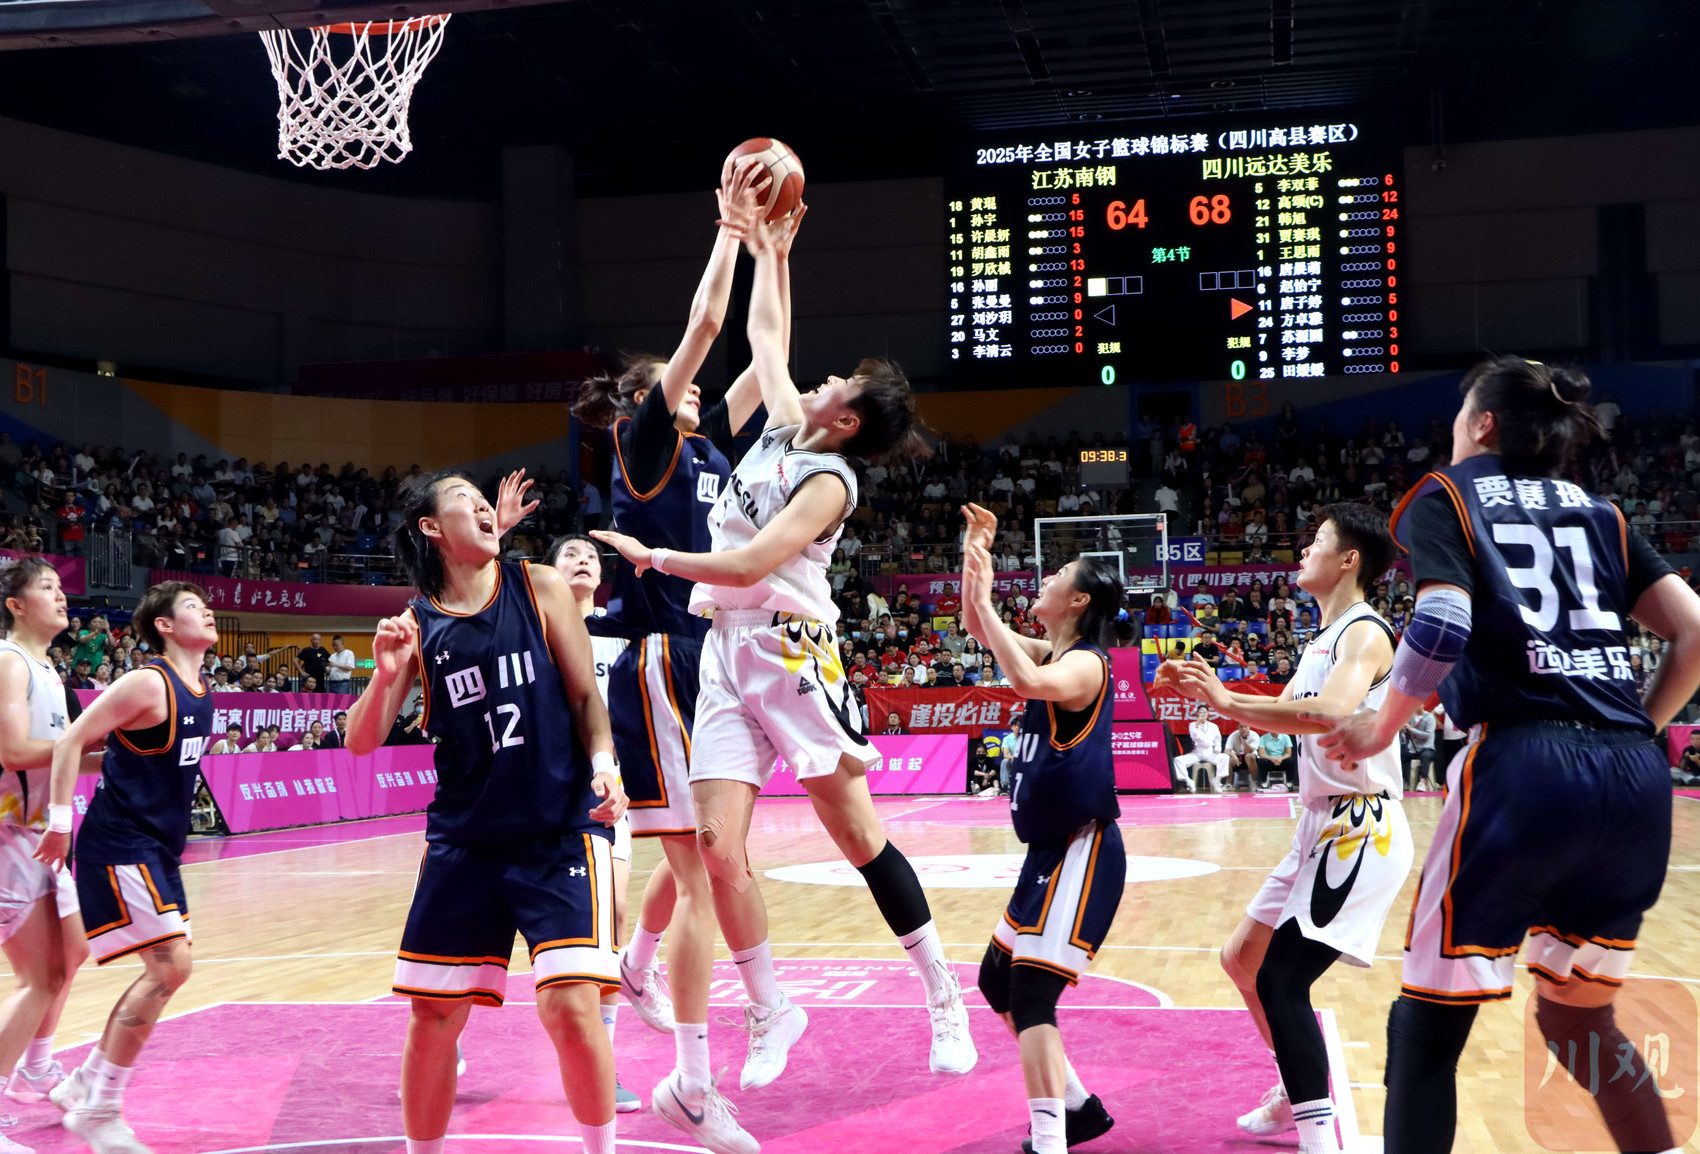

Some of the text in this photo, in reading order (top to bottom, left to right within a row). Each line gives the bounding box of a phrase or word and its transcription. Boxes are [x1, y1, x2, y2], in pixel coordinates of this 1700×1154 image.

[1202, 151, 1332, 180] 四川远达美乐
[1031, 165, 1117, 189] 江苏南钢
[1255, 183, 1263, 193] 5
[1385, 174, 1393, 185] 6
[949, 202, 962, 211] 18
[1072, 194, 1080, 204] 5
[1256, 200, 1270, 210] 12
[1382, 191, 1398, 202] 12
[949, 218, 955, 228] 1
[1069, 210, 1084, 221] 15
[1106, 198, 1148, 231] 64
[1189, 194, 1232, 226] 68
[1256, 209, 1398, 227] 21 韩旭 24
[950, 234, 963, 244] 15
[1070, 227, 1084, 237] 15
[1256, 226, 1394, 243] 31 贾赛琪 9
[950, 251, 962, 260] 11
[1073, 243, 1080, 253] 3
[1151, 246, 1191, 264] 第4节
[1257, 242, 1395, 260] 1 王思雨 9
[951, 267, 964, 276] 19
[1070, 260, 1085, 270] 13
[1257, 266, 1272, 277] 16
[1387, 259, 1395, 270] 0
[951, 283, 964, 292] 16
[1074, 276, 1082, 287] 2
[1257, 284, 1265, 294] 6
[1388, 276, 1396, 287] 0
[951, 299, 958, 309] 5
[1074, 293, 1082, 303] 9
[1258, 300, 1272, 310] 11
[1388, 293, 1397, 304] 5
[951, 315, 965, 325] 27
[1074, 309, 1082, 320] 0
[1258, 317, 1273, 328] 24
[1389, 310, 1397, 321] 0
[951, 326, 1083, 342] 20 马文 2
[1226, 336, 1251, 349] 犯规
[1258, 334, 1267, 344] 7
[1389, 327, 1398, 338] 3
[951, 349, 959, 359] 3
[1075, 342, 1083, 353] 0
[1097, 342, 1121, 354] 犯规
[1259, 351, 1268, 361] 9
[1390, 344, 1398, 355] 0
[1101, 365, 1115, 385] 0
[1231, 360, 1245, 380] 0
[1259, 368, 1275, 378] 25
[1390, 362, 1399, 373] 0
[16, 363, 47, 407] B1
[1225, 382, 1269, 417] B3
[1080, 450, 1127, 463] 09:38.3
[1473, 475, 1594, 510] 贾赛琪
[1156, 542, 1203, 561] B5区
[1492, 523, 1622, 632] 31
[445, 650, 536, 709] 四川
[909, 700, 1001, 728] 逢投必进
[483, 703, 525, 754] 12
[293, 776, 338, 796] 从我做起
[416, 769, 439, 785] 从我
